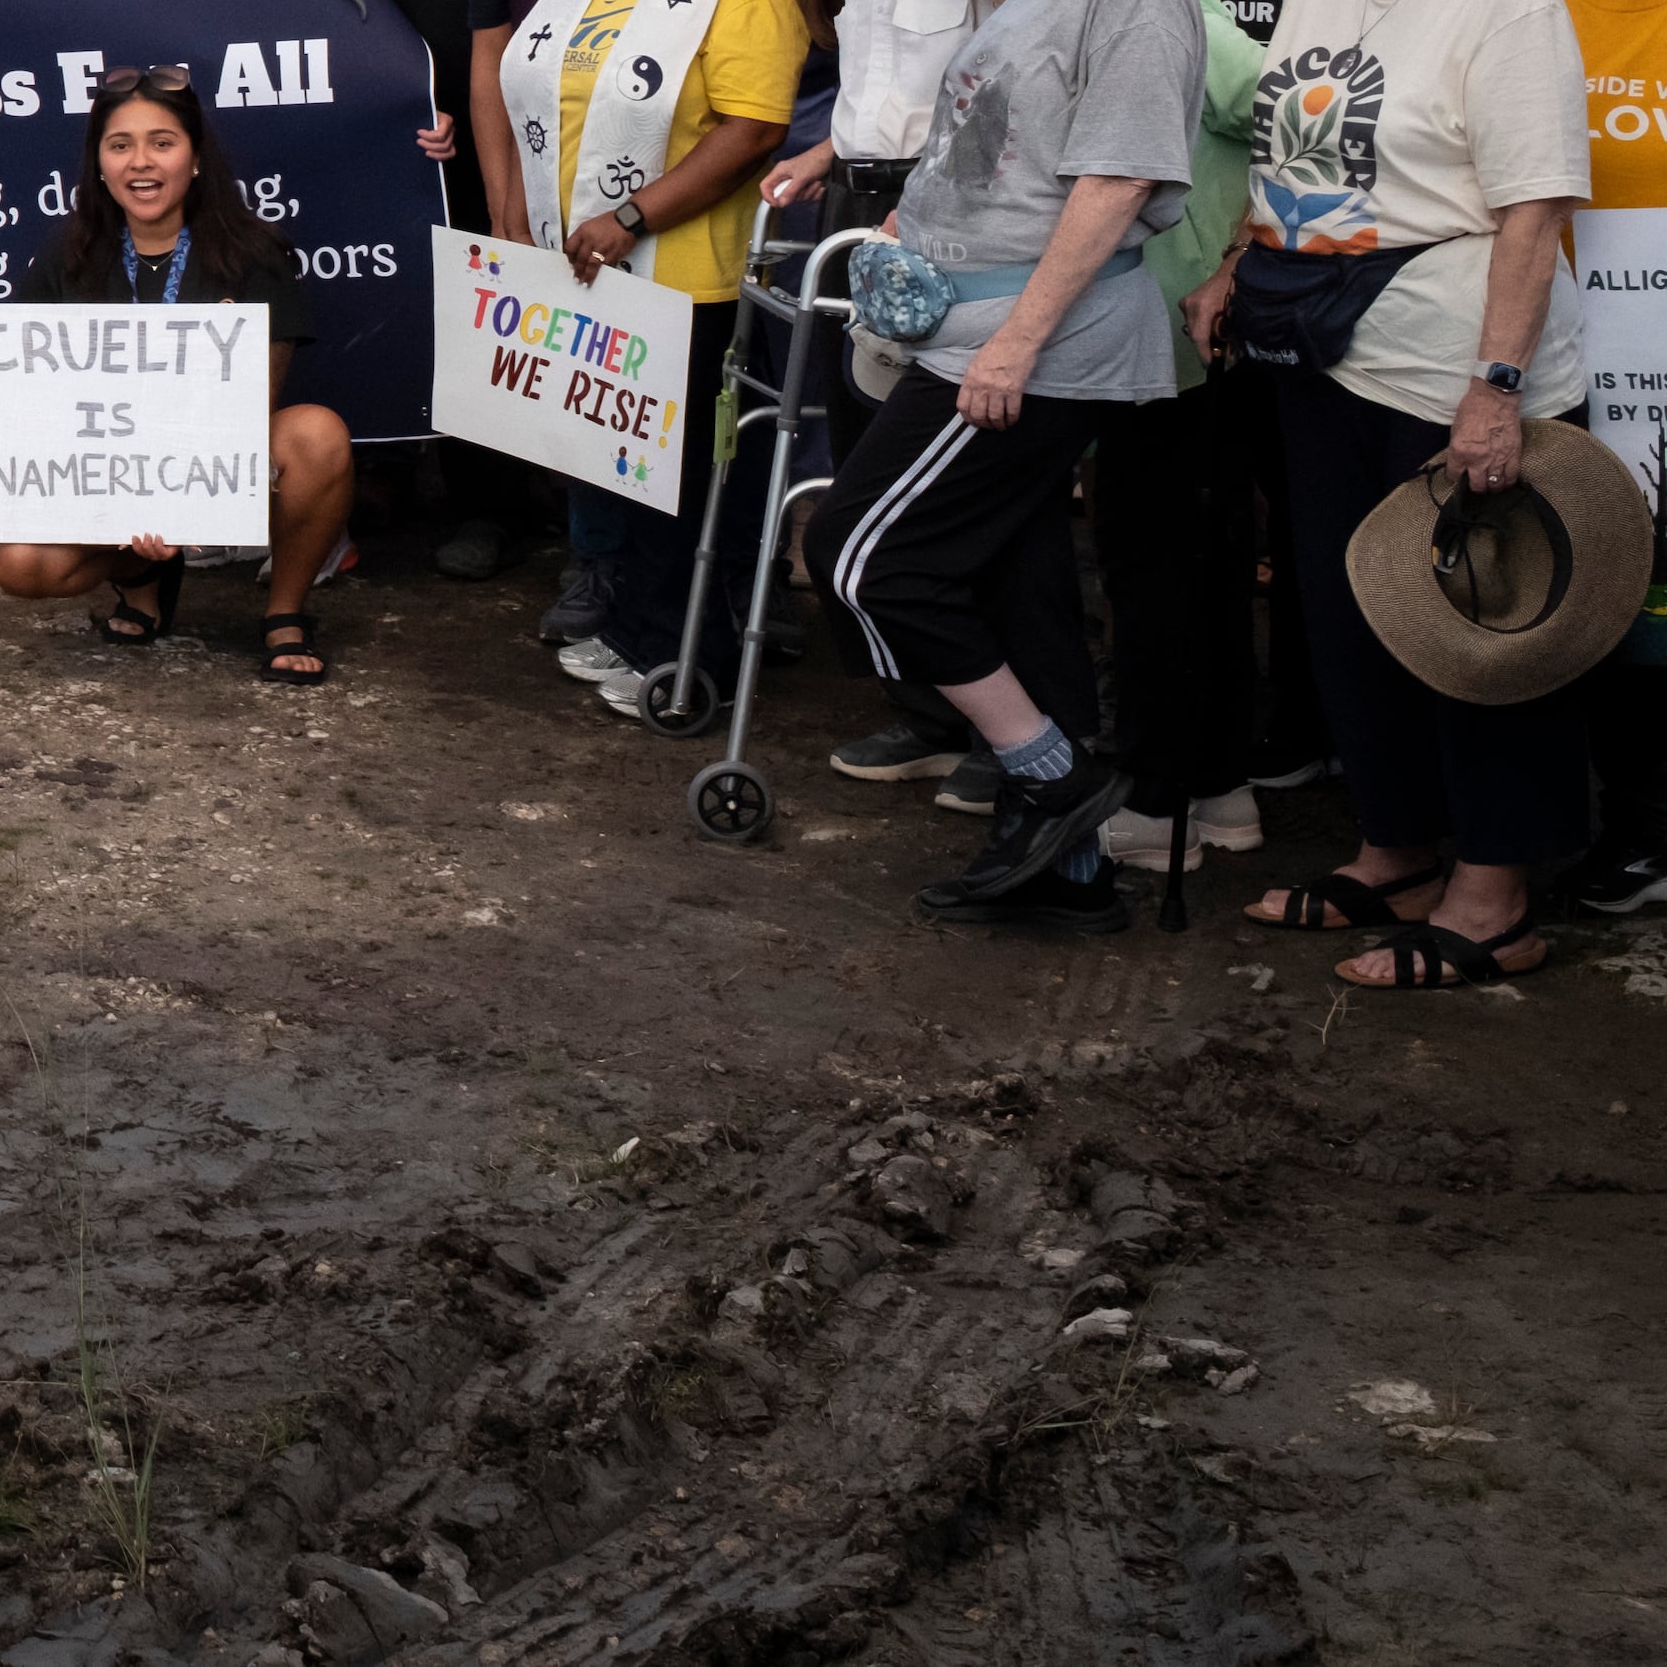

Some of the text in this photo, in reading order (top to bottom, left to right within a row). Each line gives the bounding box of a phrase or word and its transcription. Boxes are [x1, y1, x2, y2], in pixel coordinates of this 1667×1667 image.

[215, 38, 335, 109] All
[1250, 46, 1384, 192] VANCOUVER
[919, 231, 967, 262] WILD
[471, 286, 648, 382] TOGETHER
[489, 344, 679, 450] WE RISE!
[1595, 372, 1616, 390] IS
[75, 401, 135, 439] IS
[1608, 405, 1635, 421] BY
